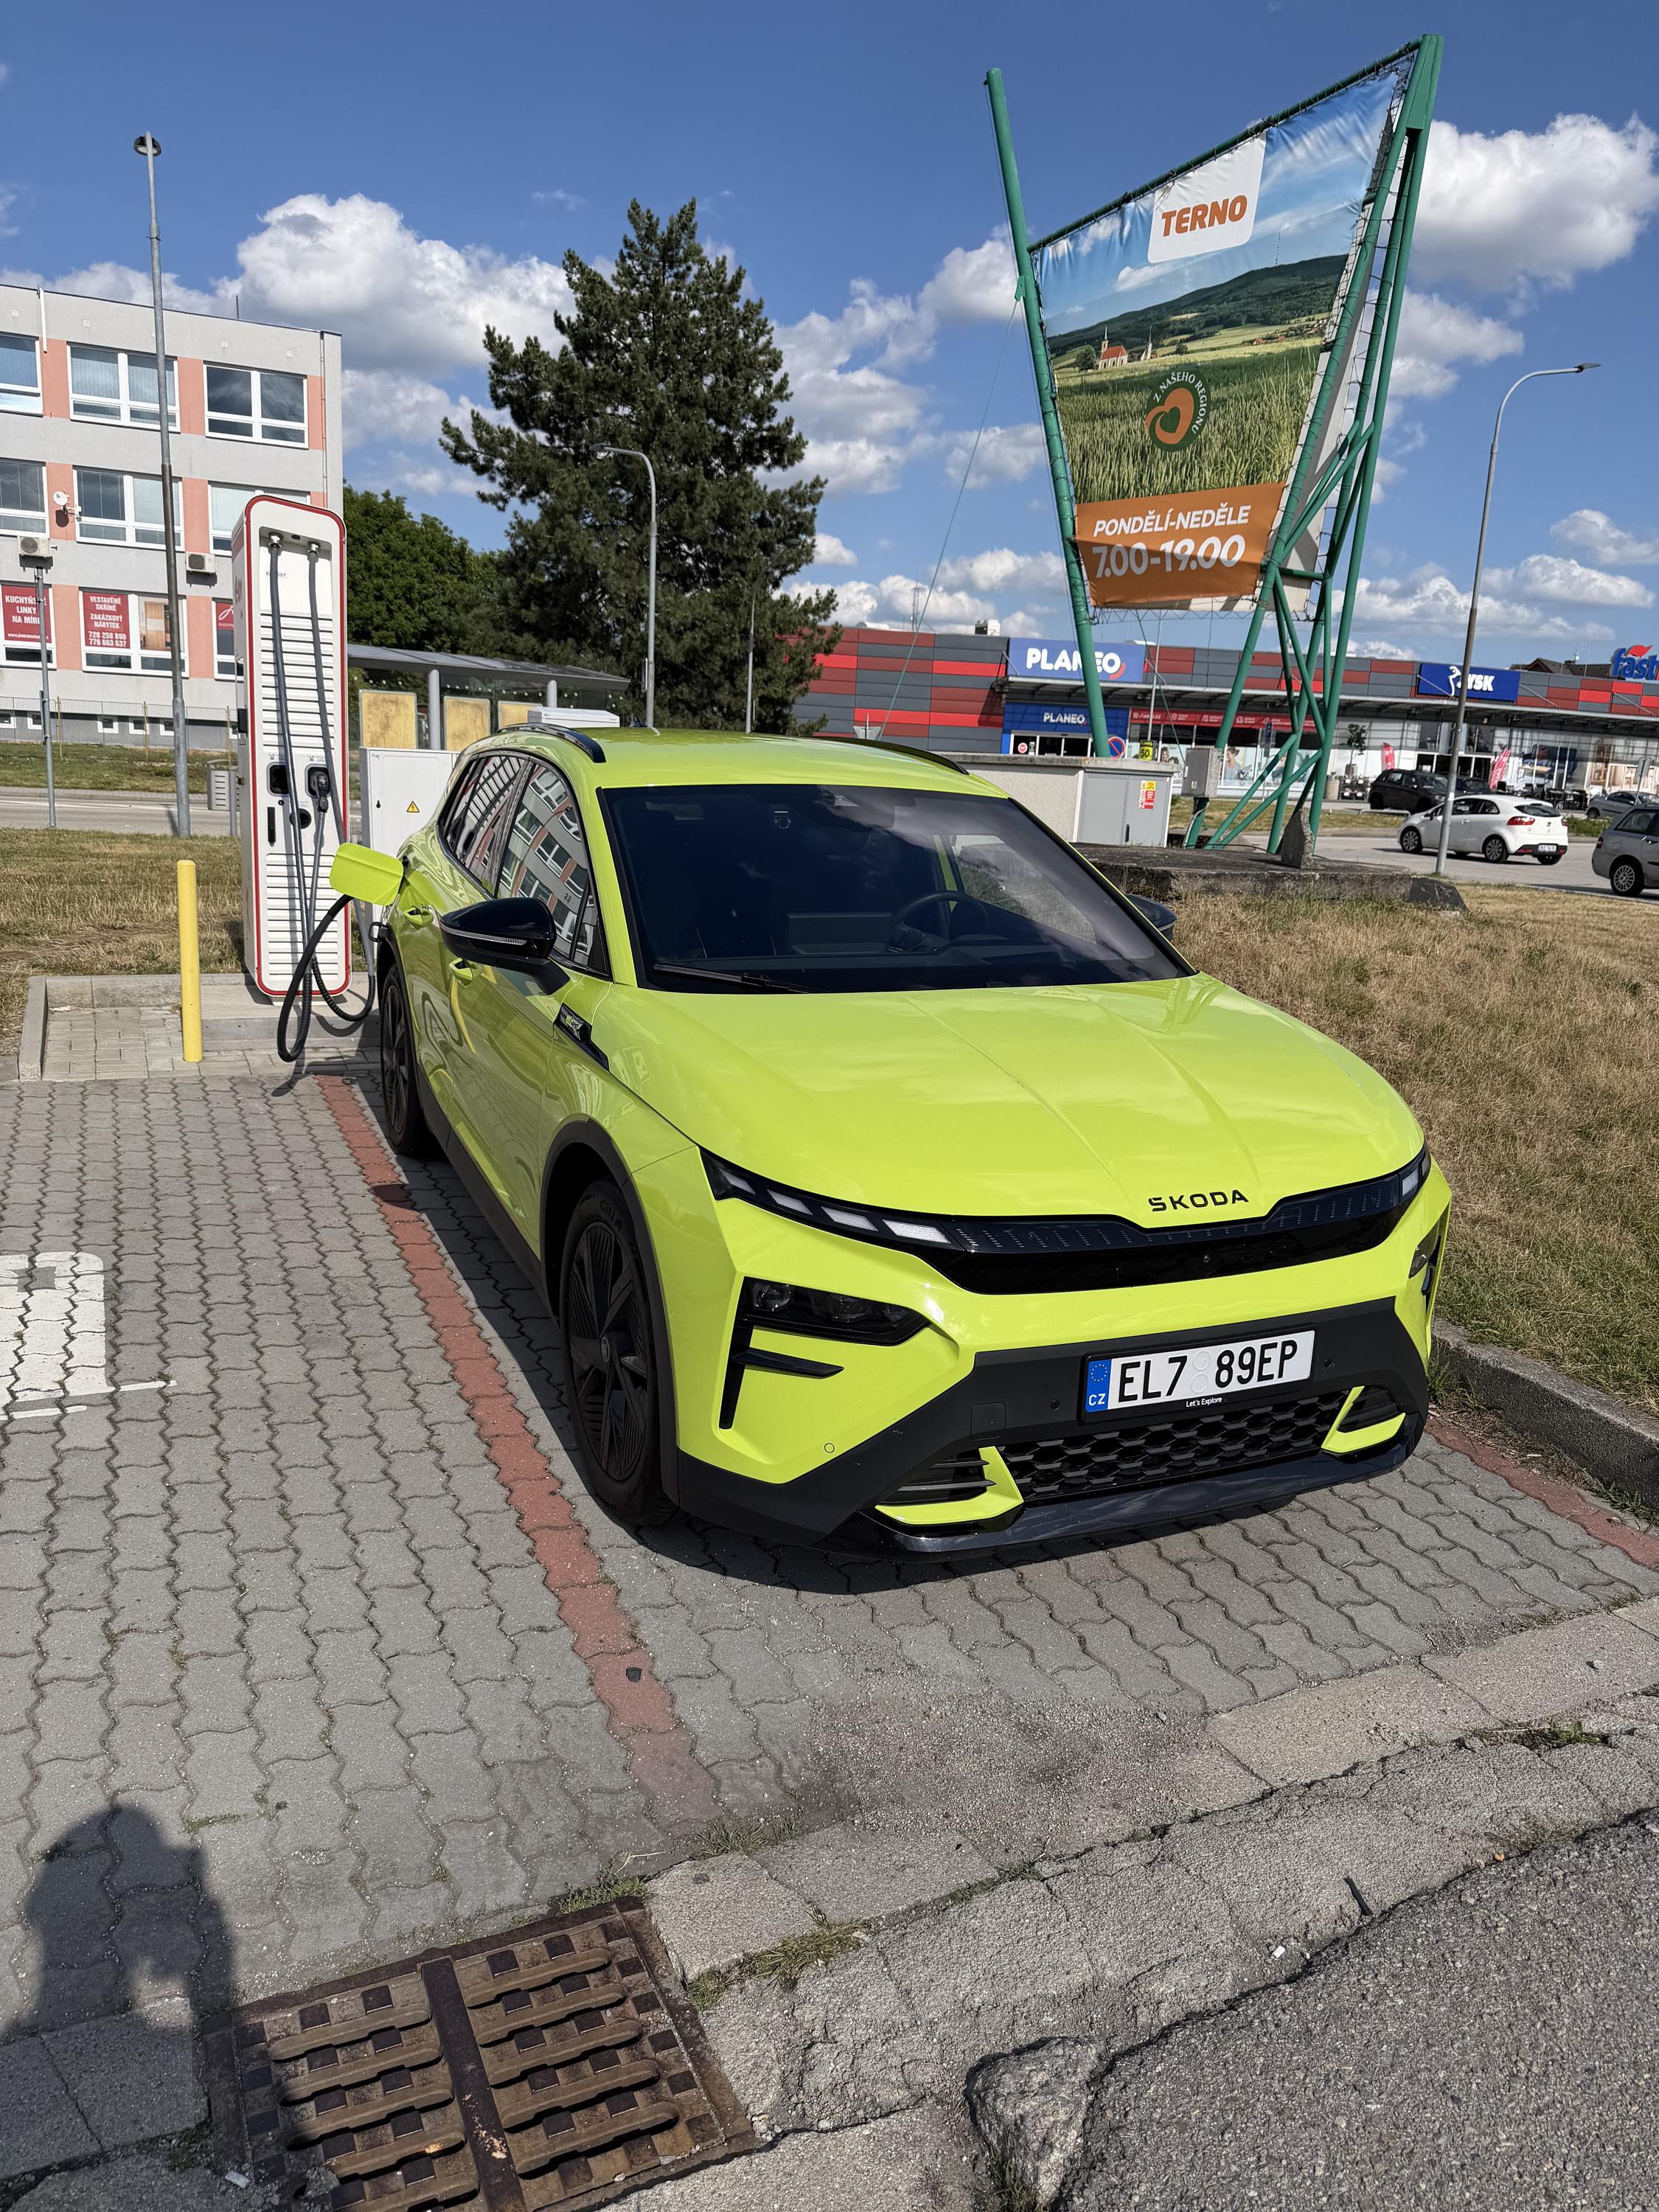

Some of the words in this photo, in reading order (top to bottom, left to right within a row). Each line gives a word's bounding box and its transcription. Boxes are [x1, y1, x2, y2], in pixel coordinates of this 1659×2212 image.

[1161, 195, 1248, 237] TERNO
[1153, 392, 1161, 403] Z
[1159, 372, 1195, 393] NAŠEHO
[1192, 380, 1207, 434] REGIONU
[1093, 502, 1251, 537] PONDĚLÍ-NEDĚLE
[1092, 534, 1245, 578] 7.00-19.00
[16, 605, 37, 614] LINKY
[12, 615, 23, 623] NA
[90, 613, 123, 622] ZAKÁZKOVÝ
[94, 620, 120, 629] NÁBYTEK
[1612, 648, 1659, 681] fast
[1043, 712, 1085, 724] PLANEO
[1118, 1355, 1188, 1402] EL7
[1215, 1339, 1298, 1388] 89EP
[1088, 1392, 1106, 1406] CZ
[1186, 1399, 1200, 1408] Let's
[1200, 1396, 1222, 1406] Explore
